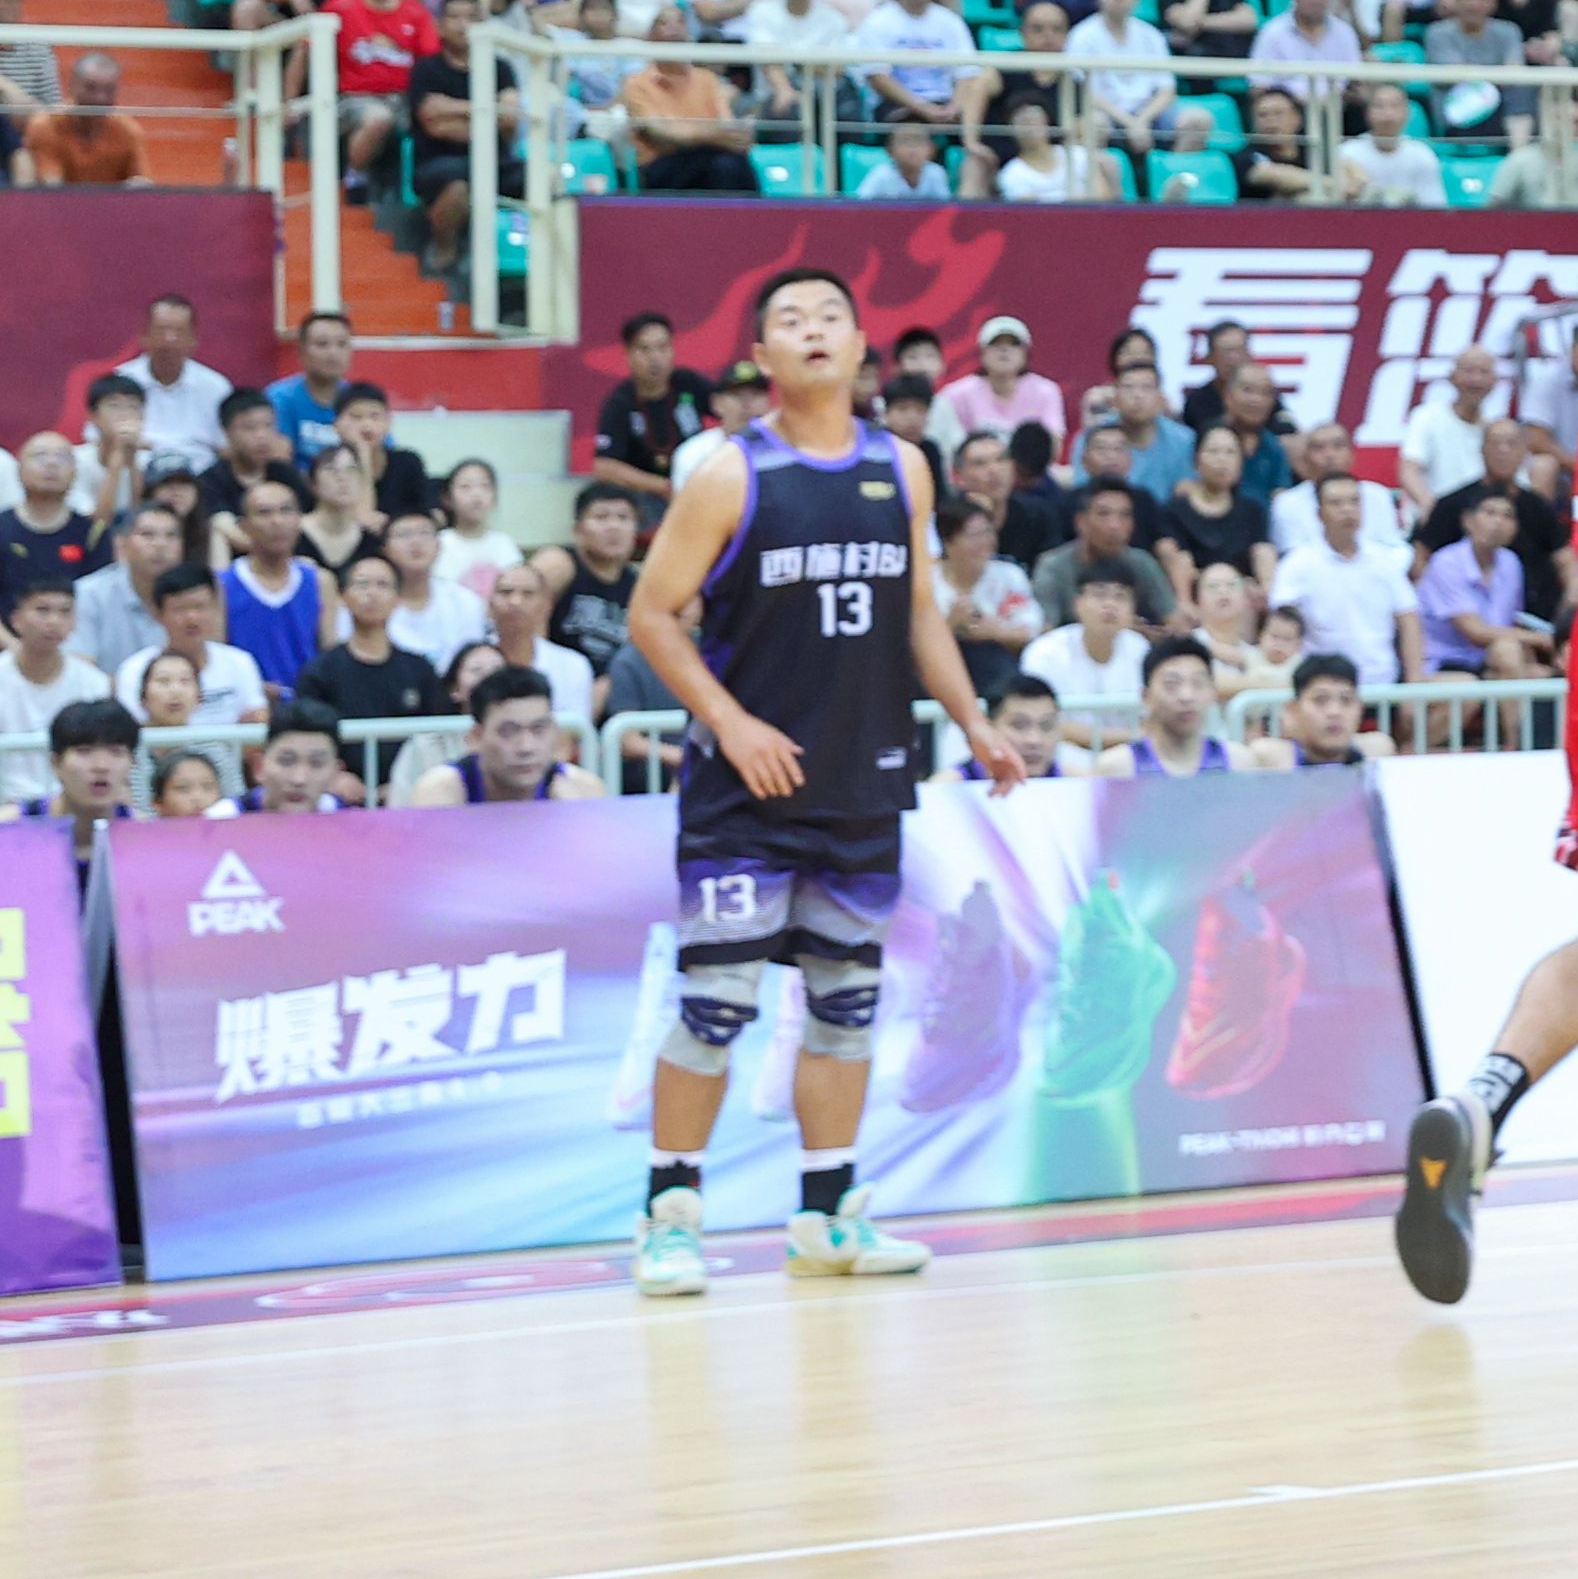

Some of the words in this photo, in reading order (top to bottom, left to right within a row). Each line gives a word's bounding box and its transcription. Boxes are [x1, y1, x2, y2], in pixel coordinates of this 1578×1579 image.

[817, 581, 873, 638] 13
[186, 897, 288, 937] PEAK
[698, 873, 757, 923] 13
[214, 949, 567, 1104] 爆发力
